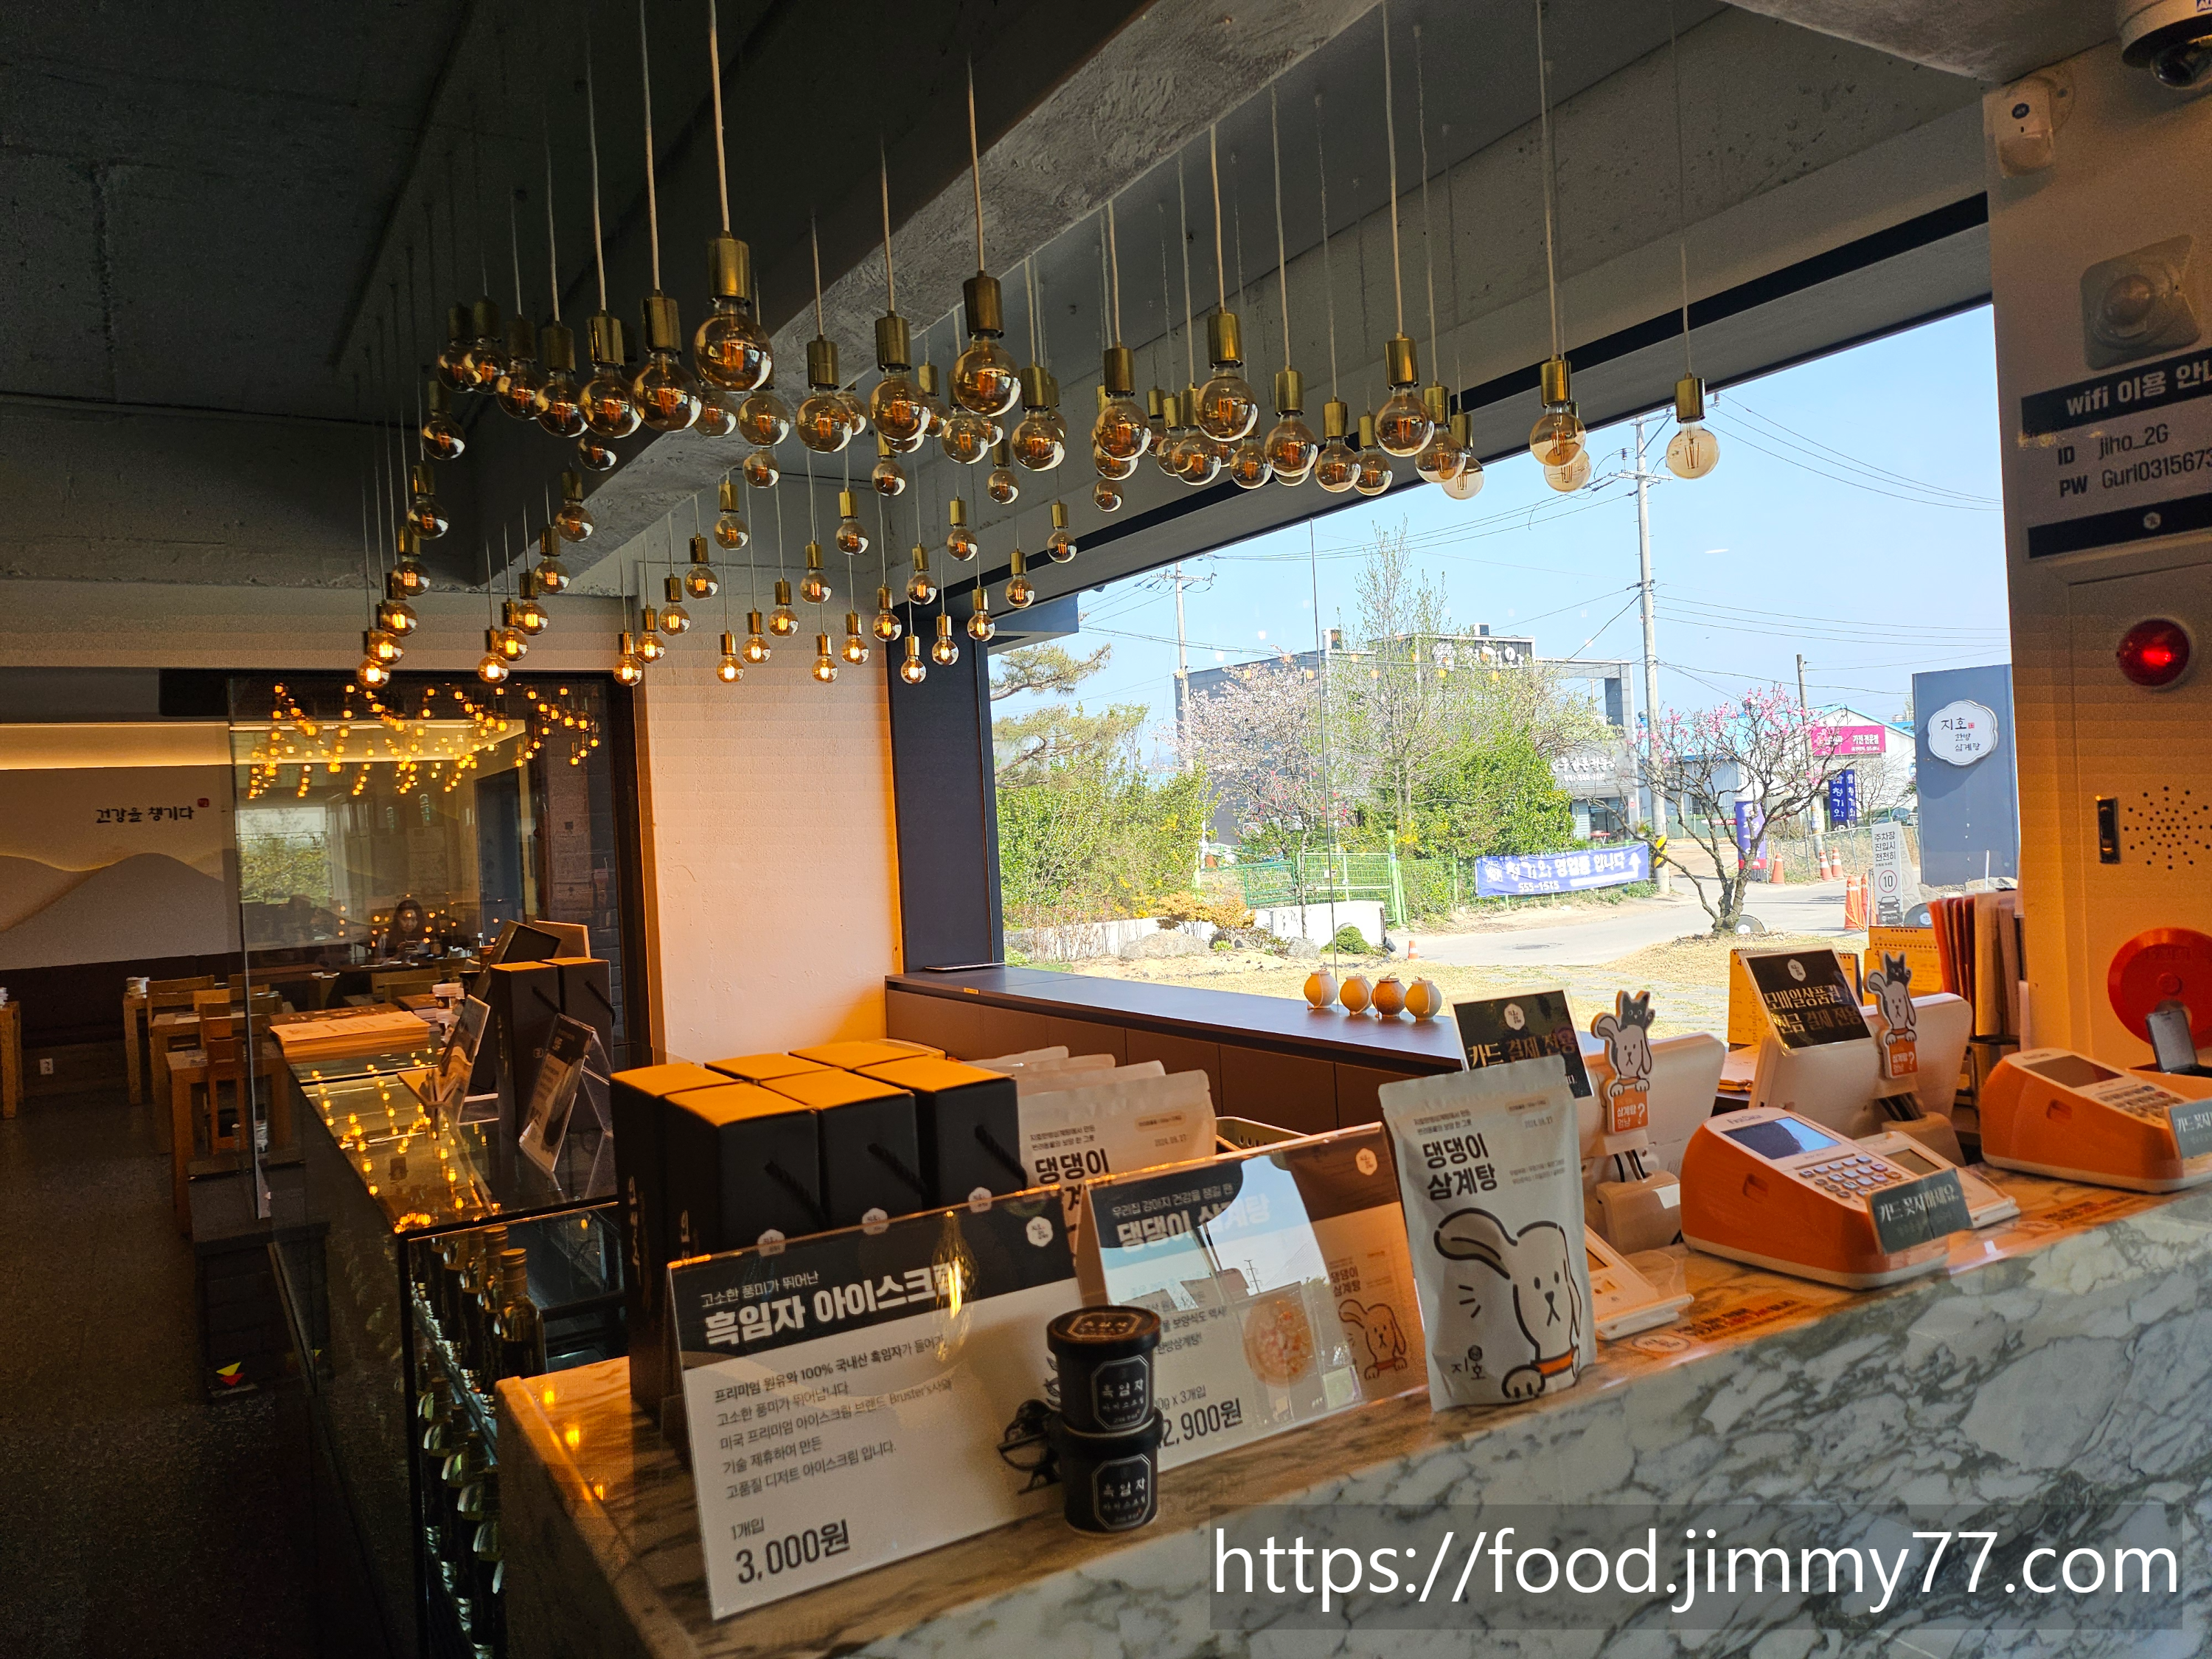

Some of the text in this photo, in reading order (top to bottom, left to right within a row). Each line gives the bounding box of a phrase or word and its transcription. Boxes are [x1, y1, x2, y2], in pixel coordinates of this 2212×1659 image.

[2066, 384, 2109, 417] wifi
[2117, 370, 2167, 403] 이용
[2057, 445, 2076, 467] ID
[2059, 475, 2089, 498] PW
[1941, 717, 1967, 731] 지호
[1955, 733, 1971, 742] 한방
[1955, 742, 1981, 752] 삼계탕
[96, 806, 195, 824] 건강을 챙기다
[1874, 831, 1896, 843] 주차장
[1874, 841, 1896, 852] 진입시
[1554, 855, 1591, 877] 영업중
[1593, 851, 1626, 873] 입니다
[1875, 851, 1896, 862] 천천히
[1883, 875, 1893, 888] 10
[1763, 984, 1843, 1010] 모바일상품권
[1803, 1008, 1834, 1031] 결제
[1832, 1004, 1862, 1026] 전용
[1467, 1042, 1503, 1068] 카드
[1507, 1034, 1541, 1062] 결제
[1422, 1133, 1489, 1169] 댕댕이
[1035, 1147, 1110, 1184] 댕댕이
[1427, 1163, 1498, 1200] 삼계탕
[701, 1270, 820, 1308] 고소한 풍미가 뛰어난
[705, 1295, 806, 1345] 흑임자
[714, 1379, 762, 1403] 프리미엄
[762, 1369, 799, 1393] 원유와
[800, 1363, 834, 1382] 100%
[835, 1353, 869, 1373] 국내산
[871, 1341, 914, 1365] 흑임자가
[1452, 1357, 1486, 1380] 지호
[1180, 1385, 1207, 1405] 3개입
[717, 1406, 754, 1427] 고소한
[756, 1395, 792, 1419] 풍미가
[720, 1433, 745, 1450] 미국
[748, 1419, 794, 1444] 프리미엄
[796, 1404, 852, 1430] 아이스크림
[854, 1397, 888, 1416] 브랜드
[1157, 1397, 1244, 1449] 2,900원
[723, 1436, 824, 1475] 기술 제휴하여 만든
[726, 1439, 897, 1500] 고품질 디저트 아이스크림 입니다.
[730, 1516, 765, 1541] 1개입
[735, 1517, 851, 1585] 3,000원
